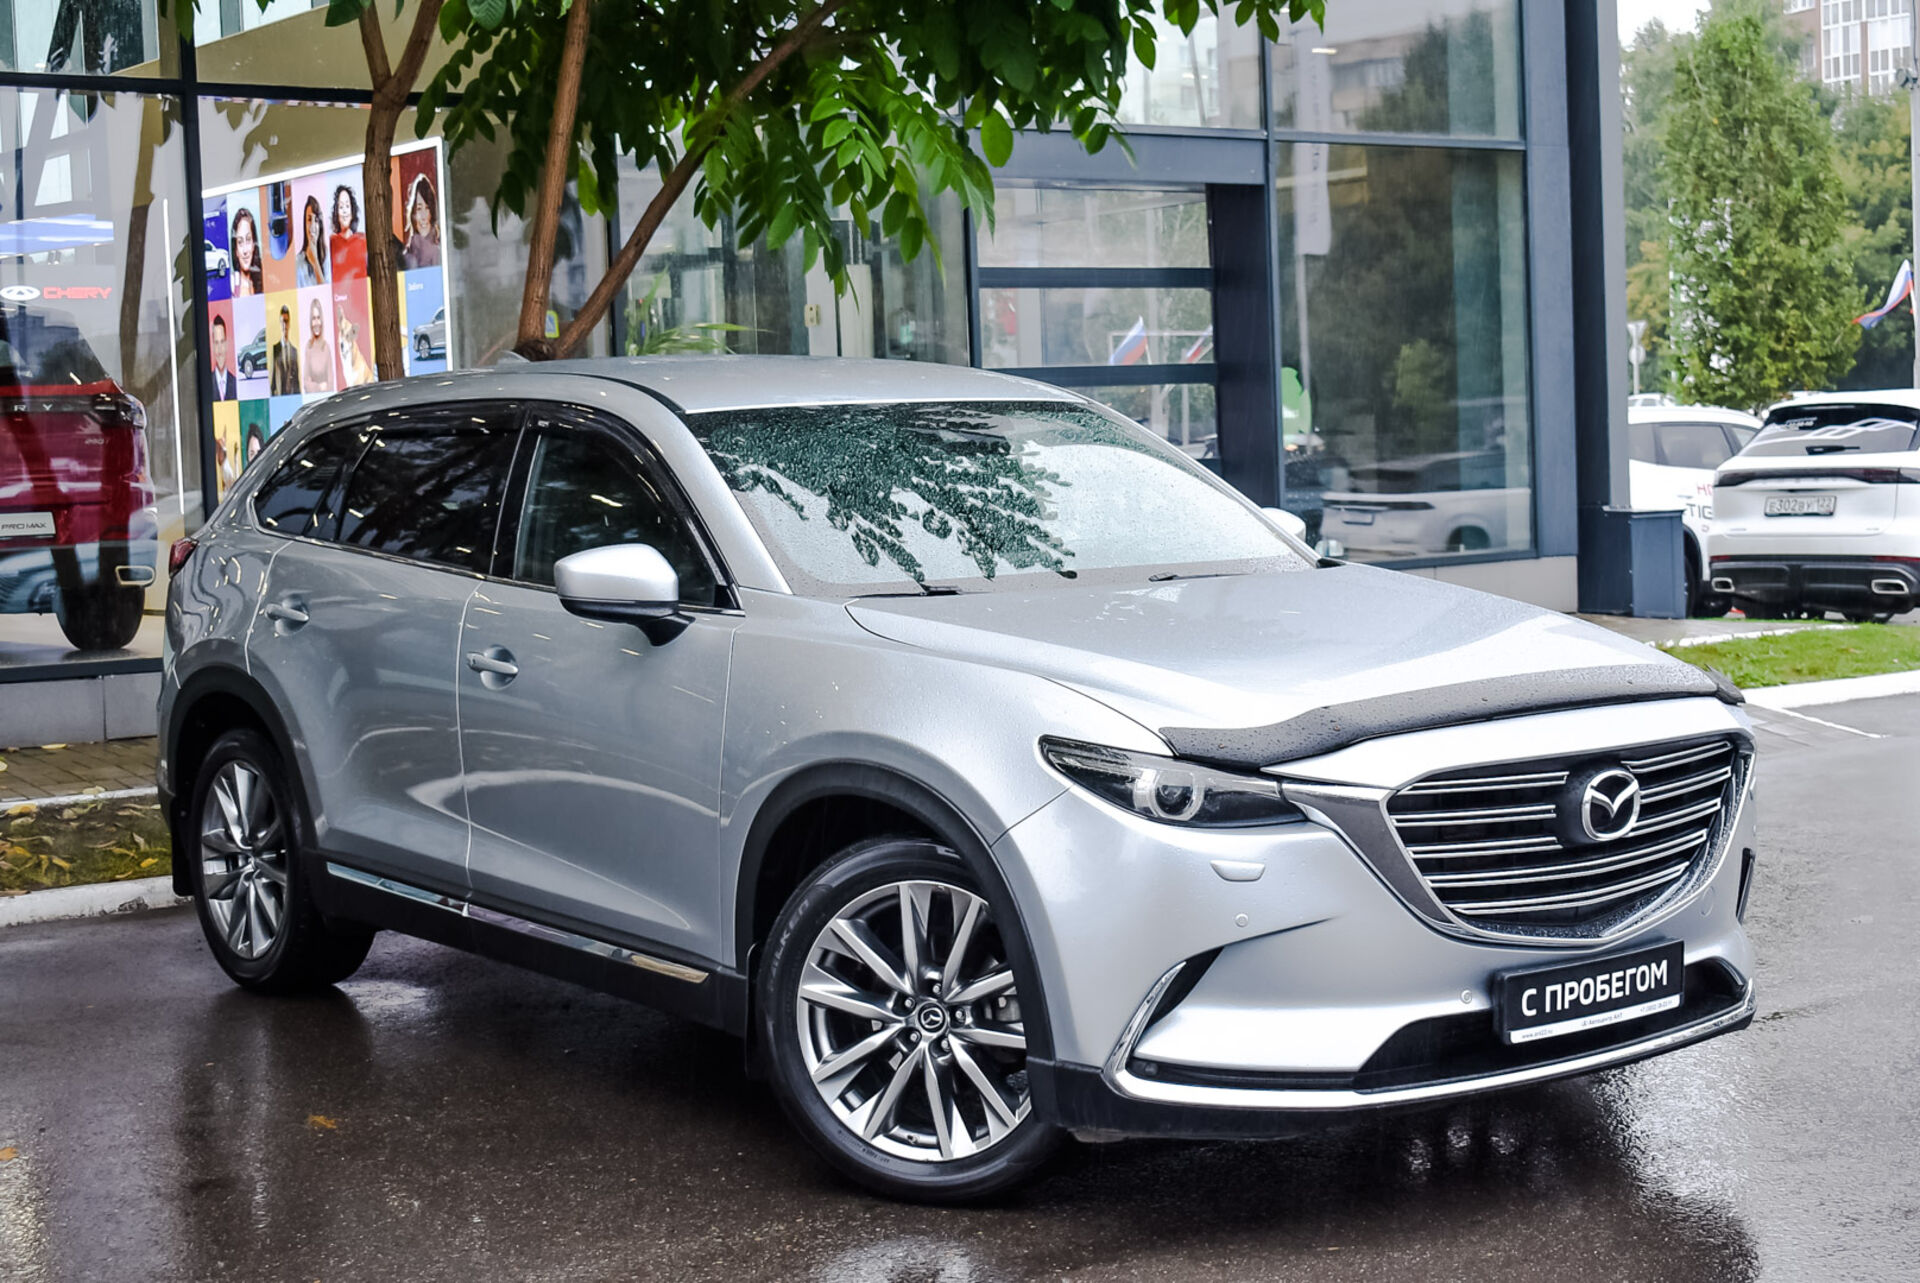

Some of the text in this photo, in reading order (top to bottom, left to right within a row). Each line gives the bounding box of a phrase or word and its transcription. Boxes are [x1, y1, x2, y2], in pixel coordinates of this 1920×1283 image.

[43, 286, 113, 300] CHERY
[1521, 959, 1668, 1017] С ПРОБЕГОМ
